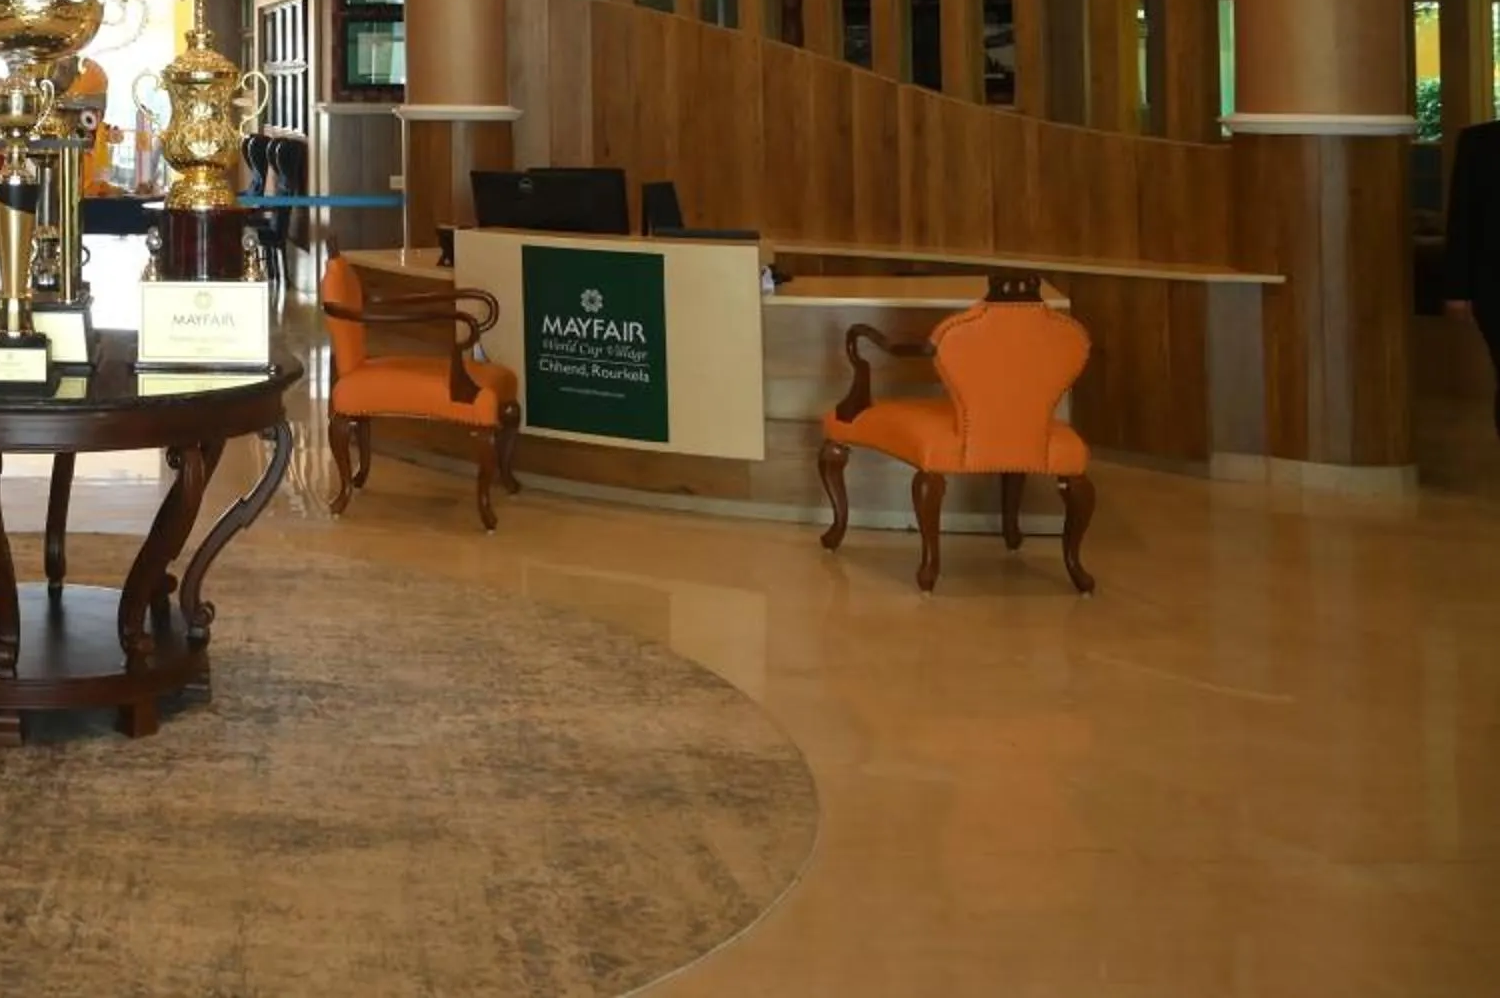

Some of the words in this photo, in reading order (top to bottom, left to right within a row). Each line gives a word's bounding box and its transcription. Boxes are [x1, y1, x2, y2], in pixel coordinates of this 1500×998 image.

[171, 312, 236, 327] MAYFAIR
[542, 314, 646, 343] MAYFAIR
[591, 363, 650, 383] Rourkela
